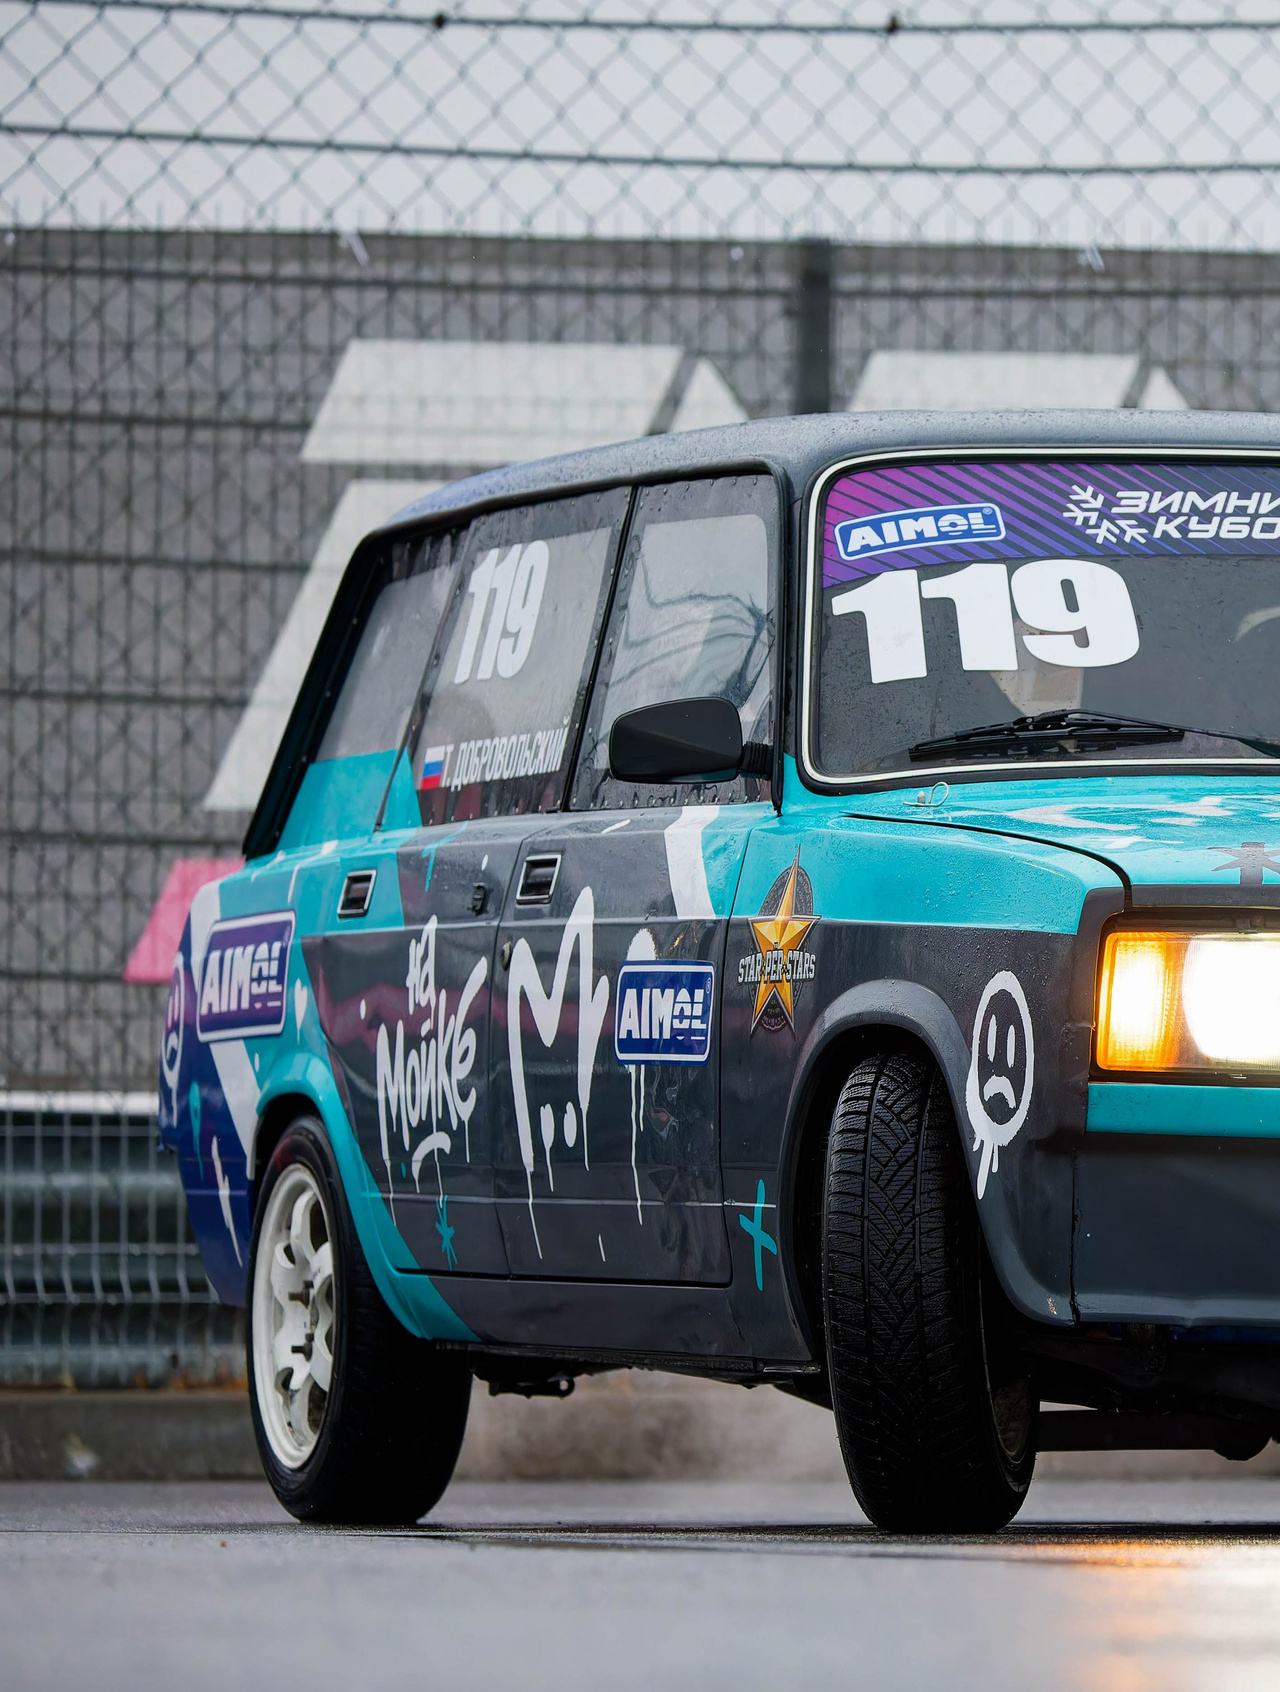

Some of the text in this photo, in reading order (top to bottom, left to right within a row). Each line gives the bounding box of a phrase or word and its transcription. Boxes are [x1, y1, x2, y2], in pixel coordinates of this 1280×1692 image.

[848, 508, 996, 553] AIMOL
[454, 539, 549, 685] 119
[831, 559, 1140, 684] 119
[451, 714, 570, 792] ДОБРОВОЛЬСКИЙ
[200, 941, 284, 1016] AIMOL
[737, 949, 816, 984] STAR PER STARS
[618, 984, 709, 1042] AIMOL
